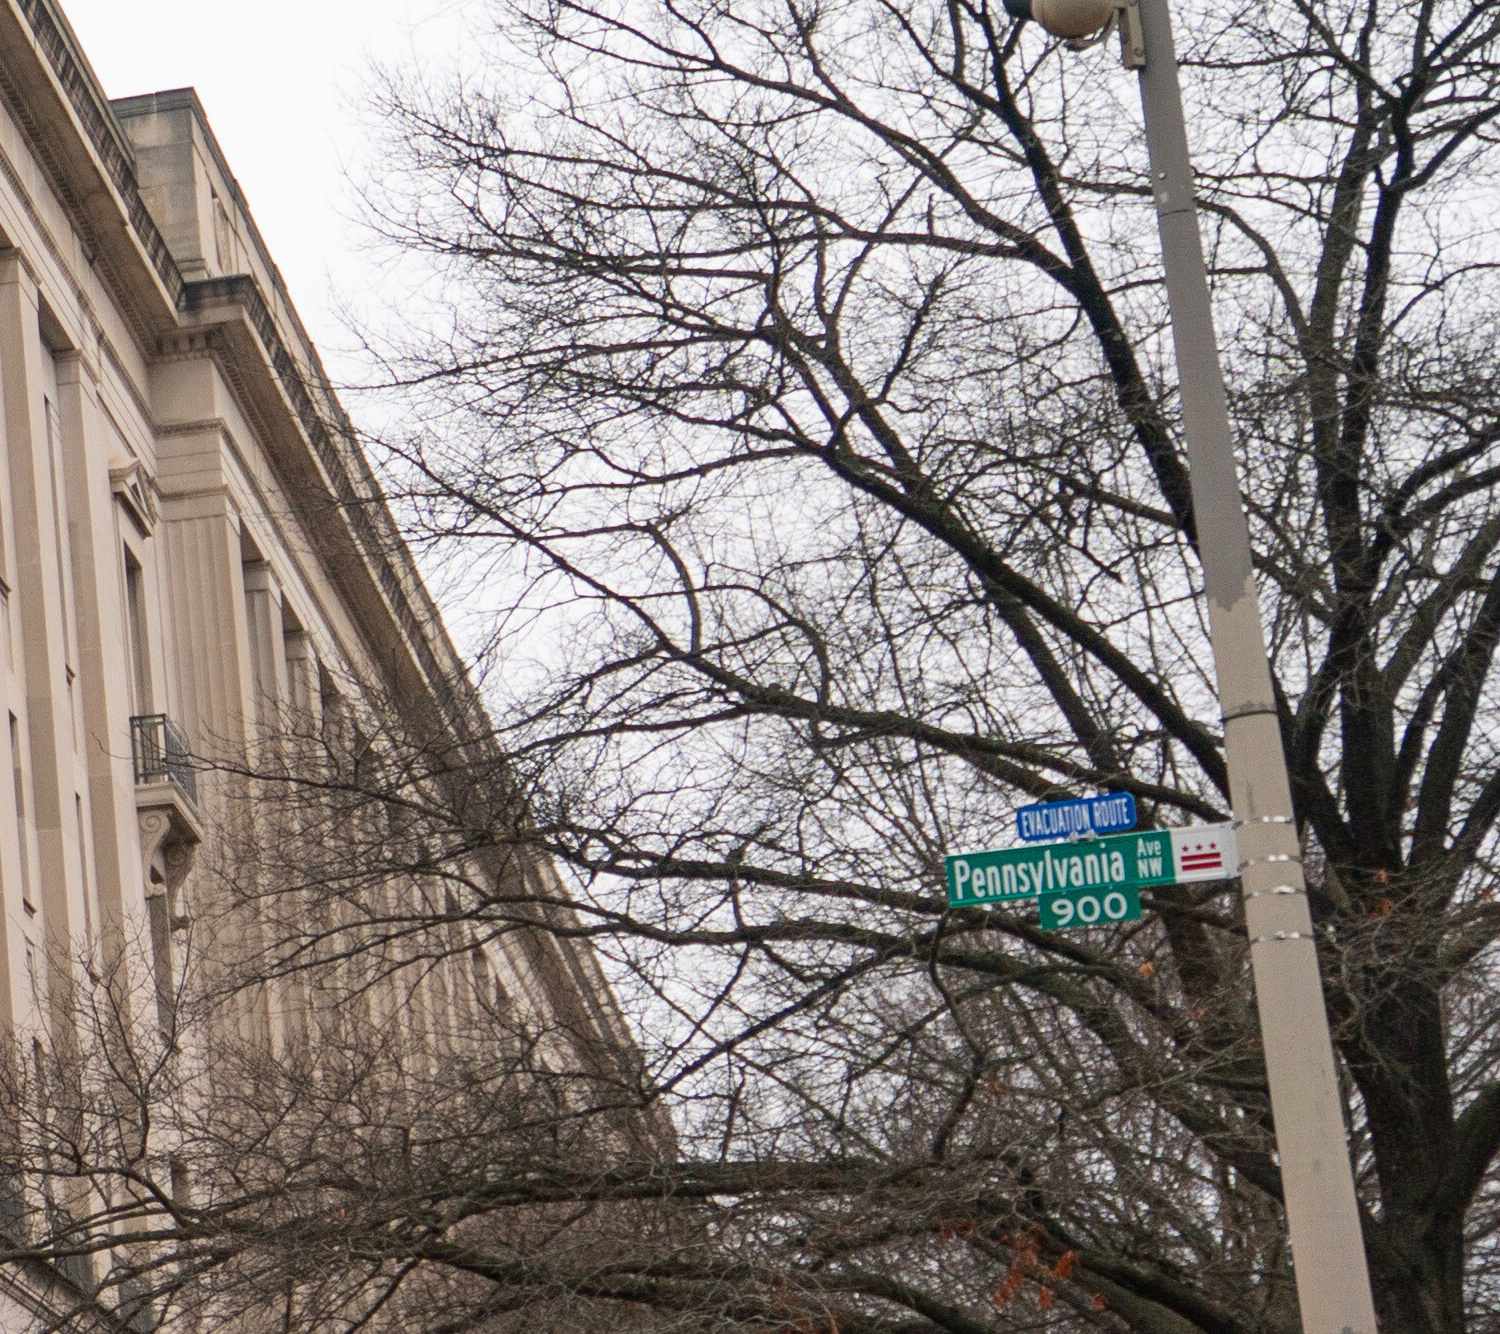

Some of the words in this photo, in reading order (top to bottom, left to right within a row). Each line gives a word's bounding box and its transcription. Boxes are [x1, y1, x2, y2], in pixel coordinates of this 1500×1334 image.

[1021, 804, 1091, 838] EVACUATION
[1092, 797, 1131, 827] ROUTE
[953, 842, 1126, 901] Pennsylvania
[1137, 838, 1162, 857] Ave
[1137, 857, 1163, 879] NW
[1051, 892, 1128, 926] 900
